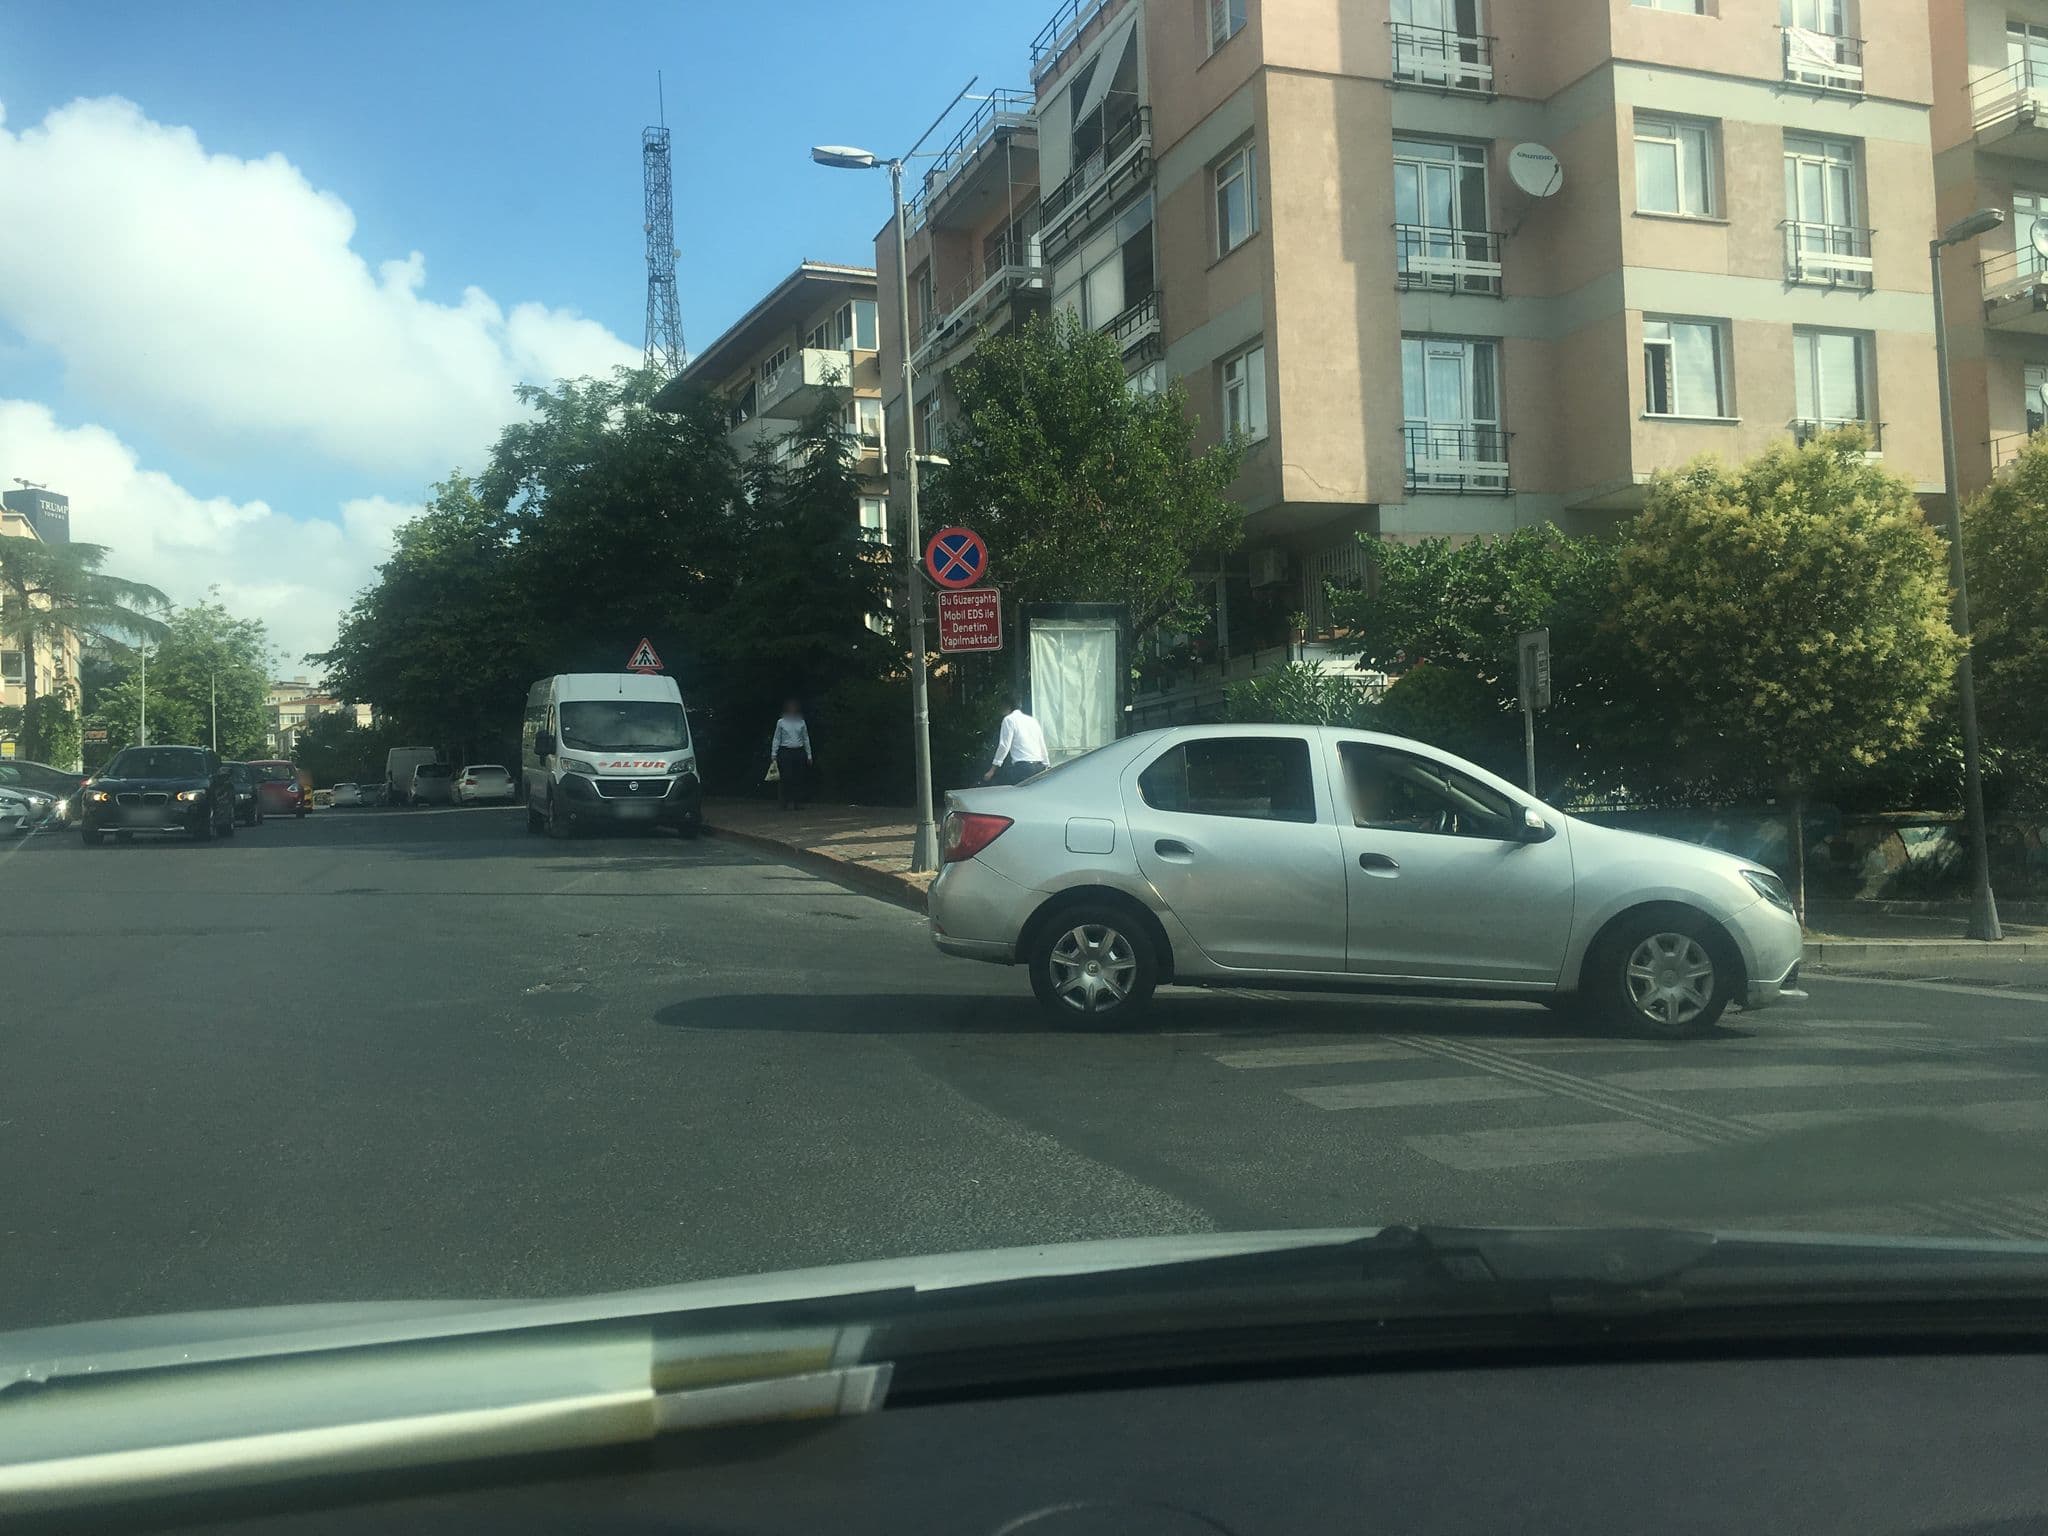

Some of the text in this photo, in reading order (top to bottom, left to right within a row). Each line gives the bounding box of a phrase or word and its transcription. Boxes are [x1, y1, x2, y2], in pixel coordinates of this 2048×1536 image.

[40, 499, 69, 515] TRUMP
[941, 593, 997, 606] Bu Güzergahta
[944, 609, 995, 621] Mobil EDS ile
[953, 622, 988, 633] Denetim
[943, 634, 998, 648] Yapılmaktadır
[609, 761, 667, 769] ALTUR
